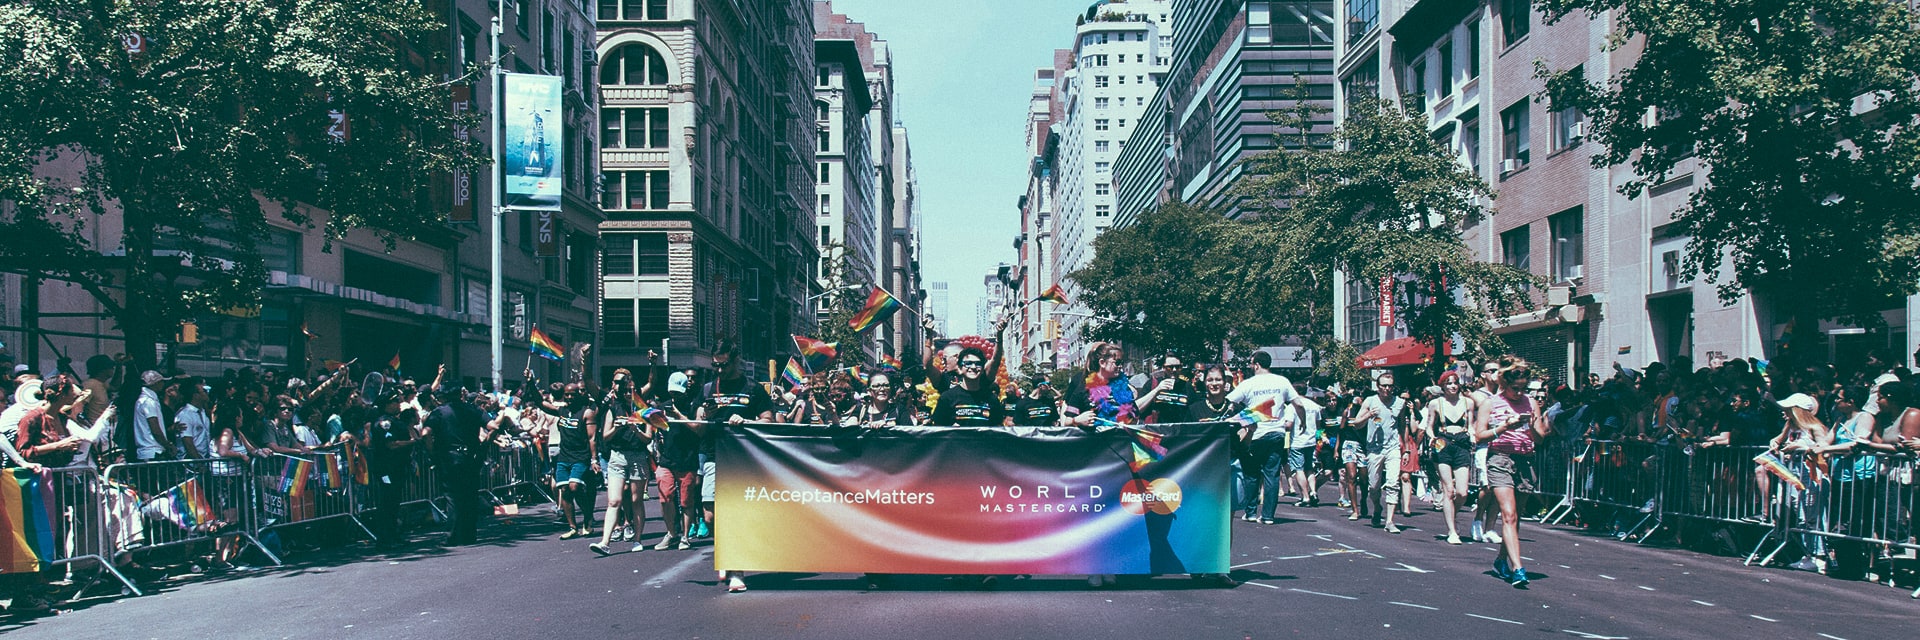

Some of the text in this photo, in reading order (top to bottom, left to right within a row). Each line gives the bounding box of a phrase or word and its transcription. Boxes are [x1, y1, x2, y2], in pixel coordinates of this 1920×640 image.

[1382, 294, 1391, 324] MARKET
[744, 486, 935, 504] #AcceptanceMatters
[980, 485, 1103, 498] WORLD
[1121, 491, 1180, 503] MasterCard
